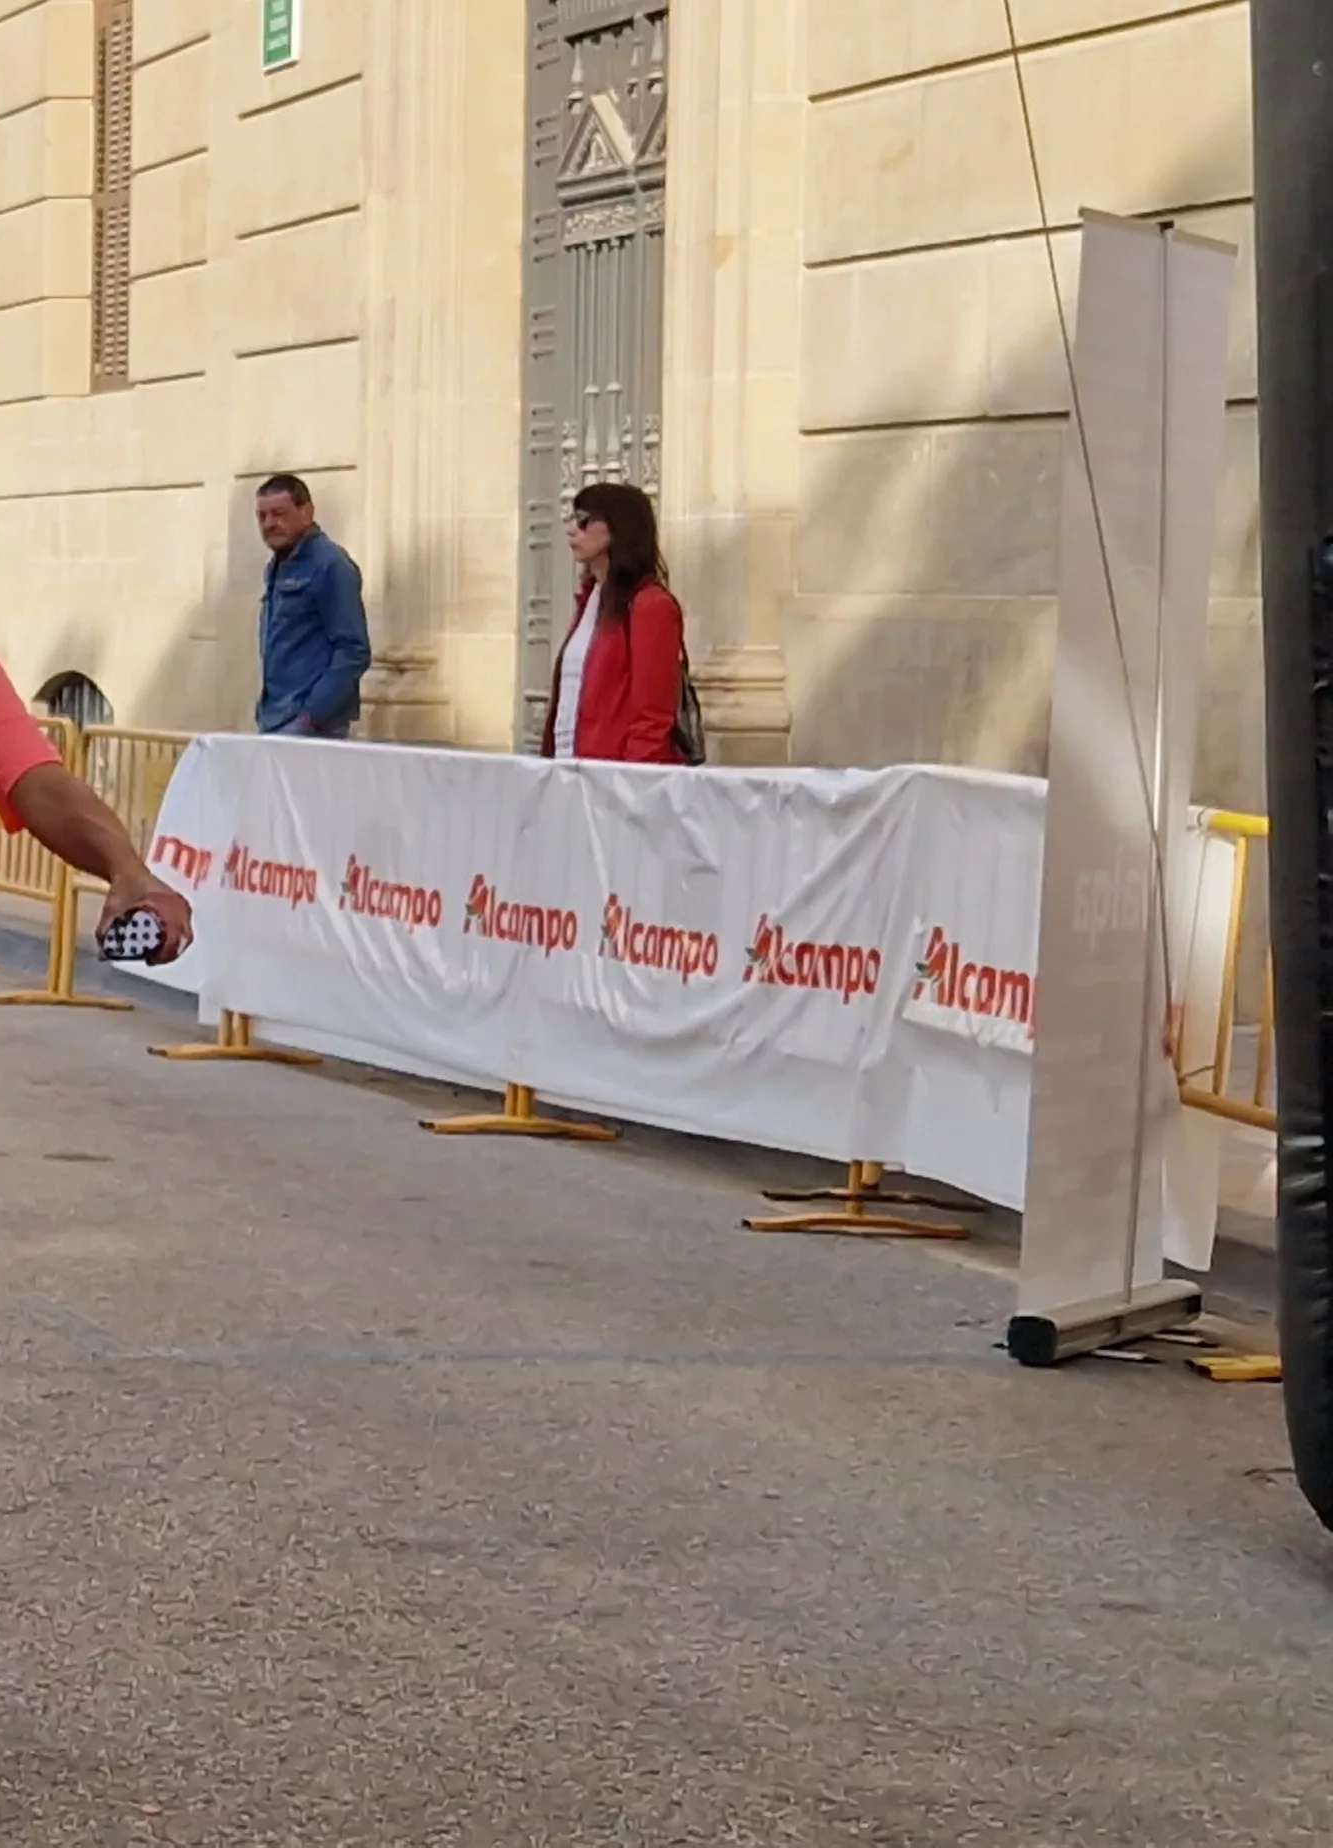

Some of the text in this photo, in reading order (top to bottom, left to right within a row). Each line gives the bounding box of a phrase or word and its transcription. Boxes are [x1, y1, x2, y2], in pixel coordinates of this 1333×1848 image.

[220, 840, 318, 908] Alcampo
[339, 854, 442, 933] Alcampo
[463, 873, 578, 957] Alcampo
[598, 893, 719, 984] Alcampo
[743, 913, 882, 1004] Alcampo
[912, 926, 1037, 1034] Alcam
